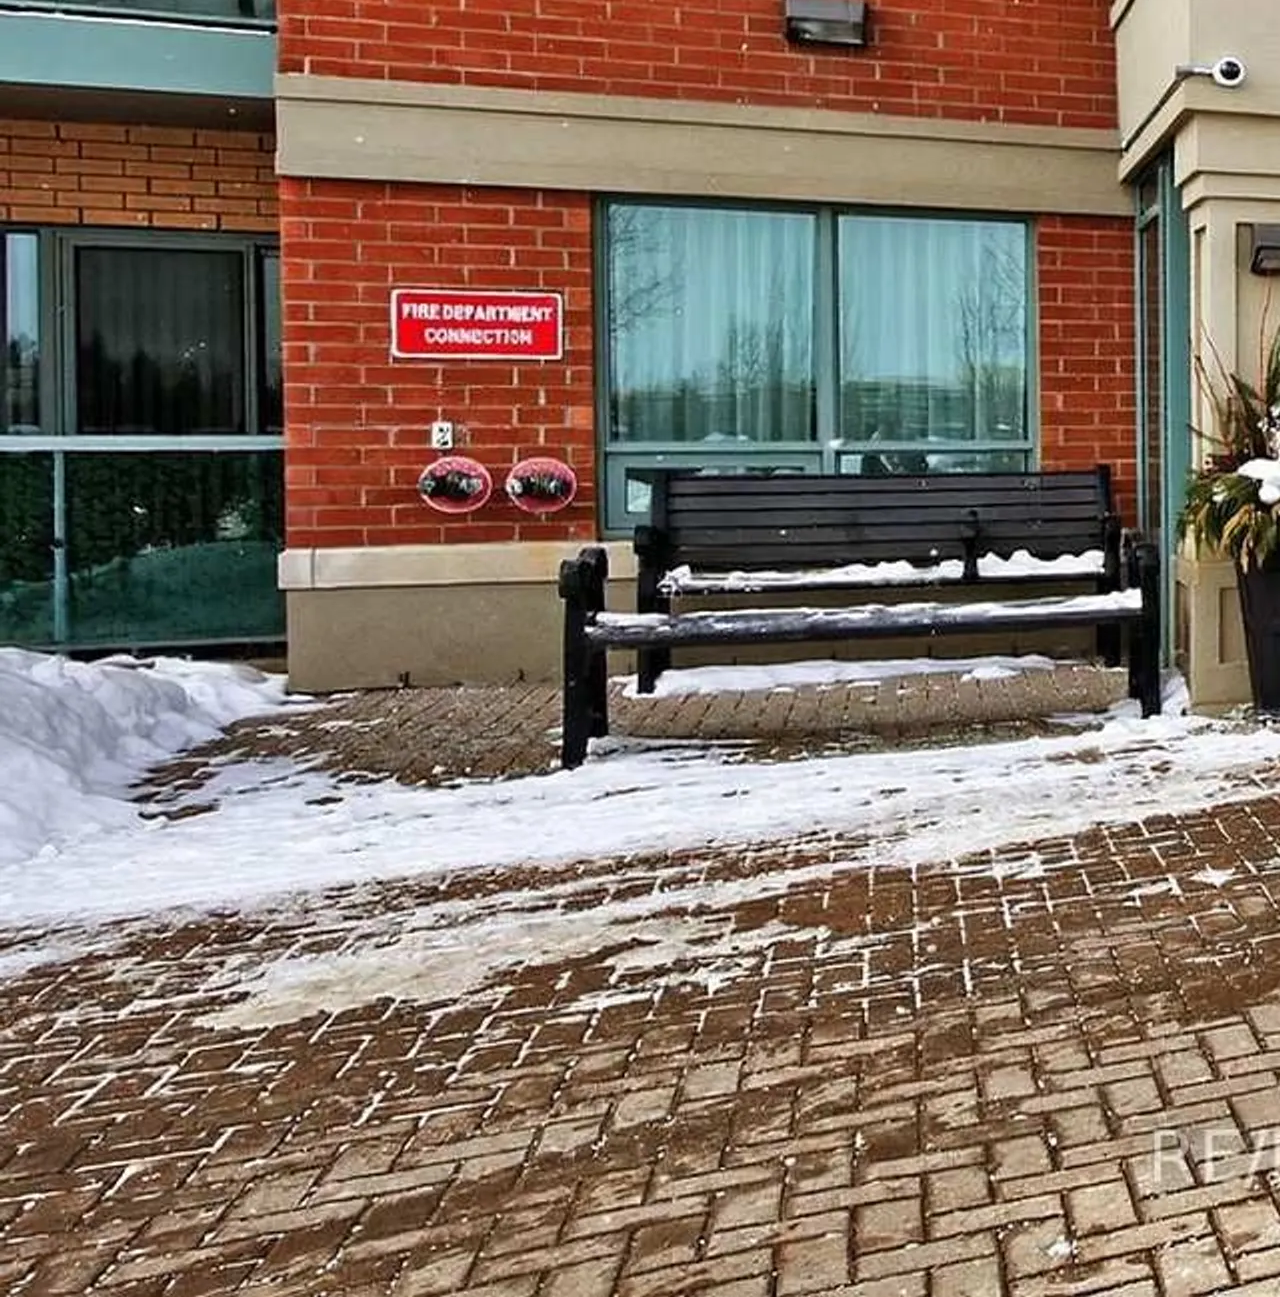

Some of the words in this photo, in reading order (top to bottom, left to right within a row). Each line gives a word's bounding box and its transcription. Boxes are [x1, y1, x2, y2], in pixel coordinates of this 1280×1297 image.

[402, 303, 440, 320] FIRE
[442, 304, 554, 322] DEPARTMENT
[424, 327, 534, 345] CONNECTION
